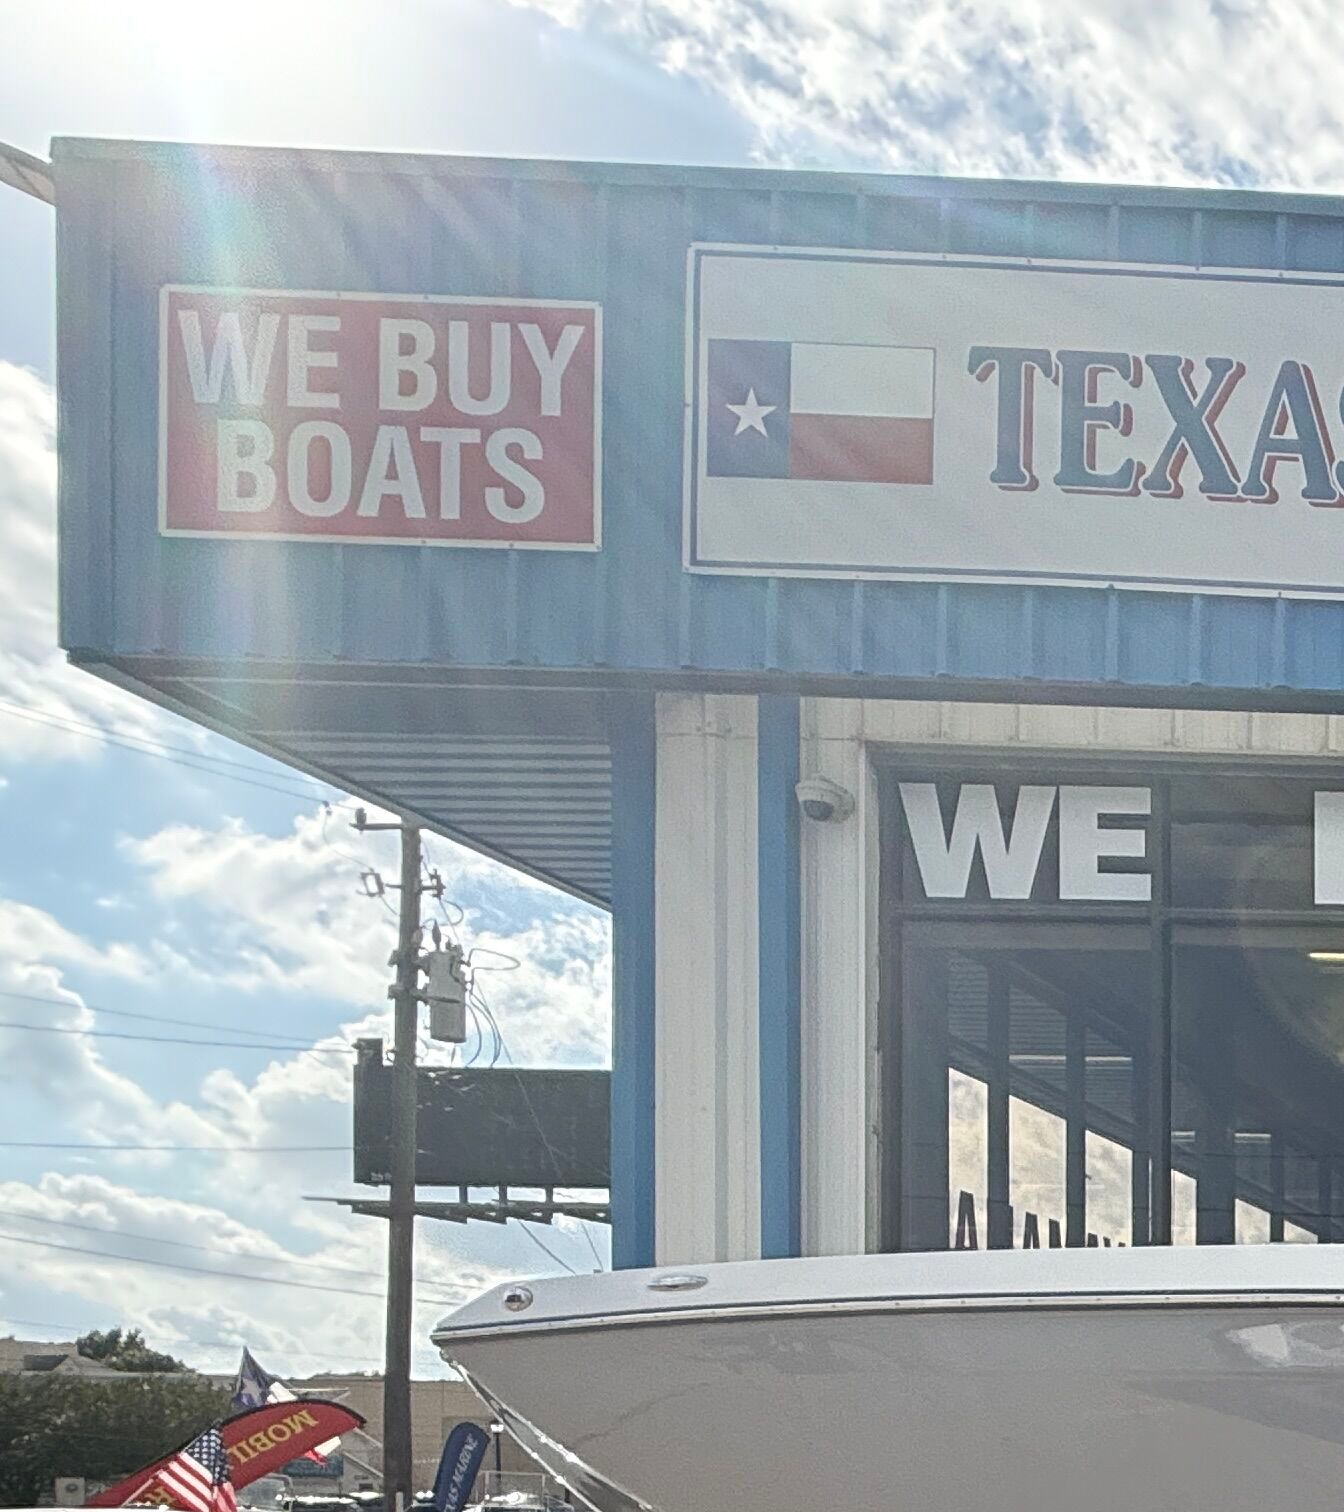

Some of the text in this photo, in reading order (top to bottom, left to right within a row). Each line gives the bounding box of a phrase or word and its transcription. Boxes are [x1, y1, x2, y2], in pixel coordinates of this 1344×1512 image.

[179, 308, 587, 418] WE BUY
[215, 416, 546, 526] BOATS
[898, 781, 1153, 903] WE
[226, 1409, 319, 1465] MOBIL
